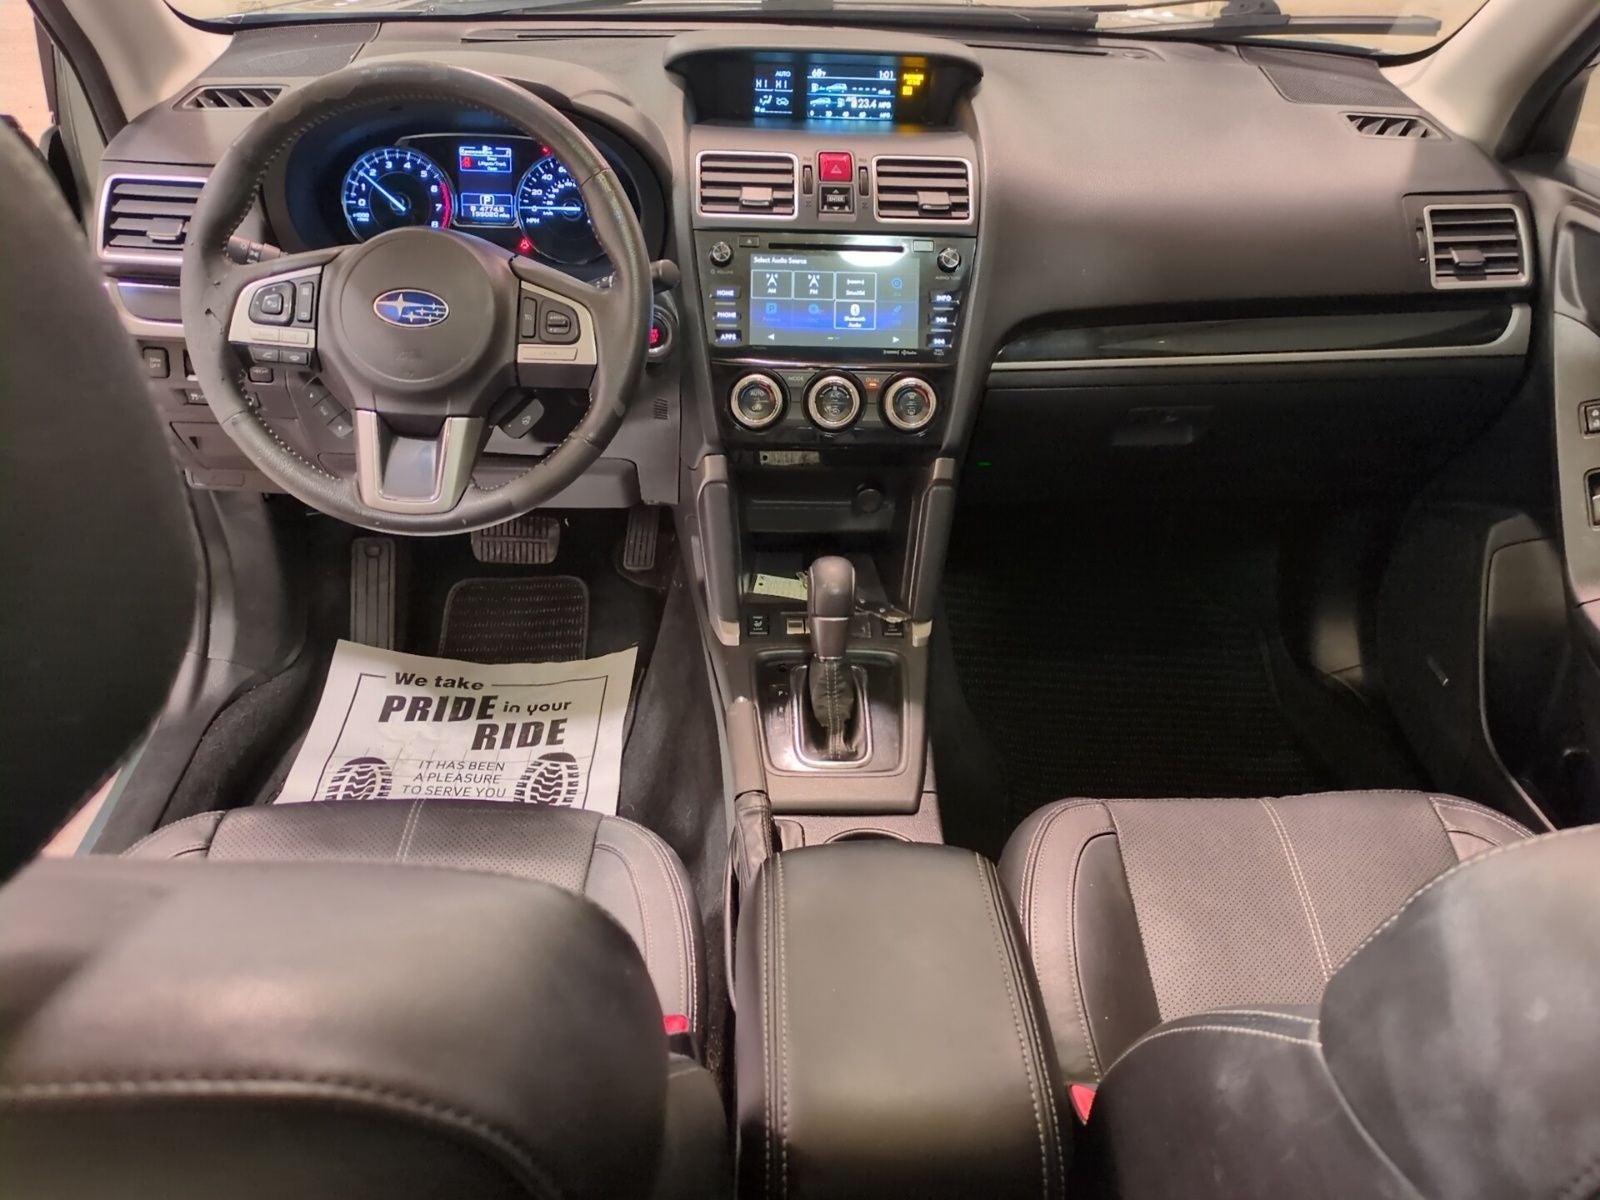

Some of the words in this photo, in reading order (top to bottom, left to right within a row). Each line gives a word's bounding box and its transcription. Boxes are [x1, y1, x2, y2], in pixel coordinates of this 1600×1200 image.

[385, 161, 392, 169] 3
[420, 170, 428, 178] 5
[361, 183, 366, 191] 1
[484, 194, 491, 205] P
[753, 256, 770, 264] Select
[788, 257, 807, 265] Source
[395, 672, 427, 687] We
[435, 675, 484, 691] take
[378, 695, 499, 722] PRIDE
[503, 701, 520, 713] in
[527, 701, 572, 716] your
[471, 718, 568, 750] RIDE
[418, 761, 434, 770] IT
[436, 761, 465, 771] HAS
[468, 761, 505, 771] BEEN
[413, 774, 423, 782] A
[426, 773, 502, 784] PLEASURE
[402, 785, 422, 795] TO
[425, 785, 472, 797] SERVE
[476, 786, 507, 798] YOU
